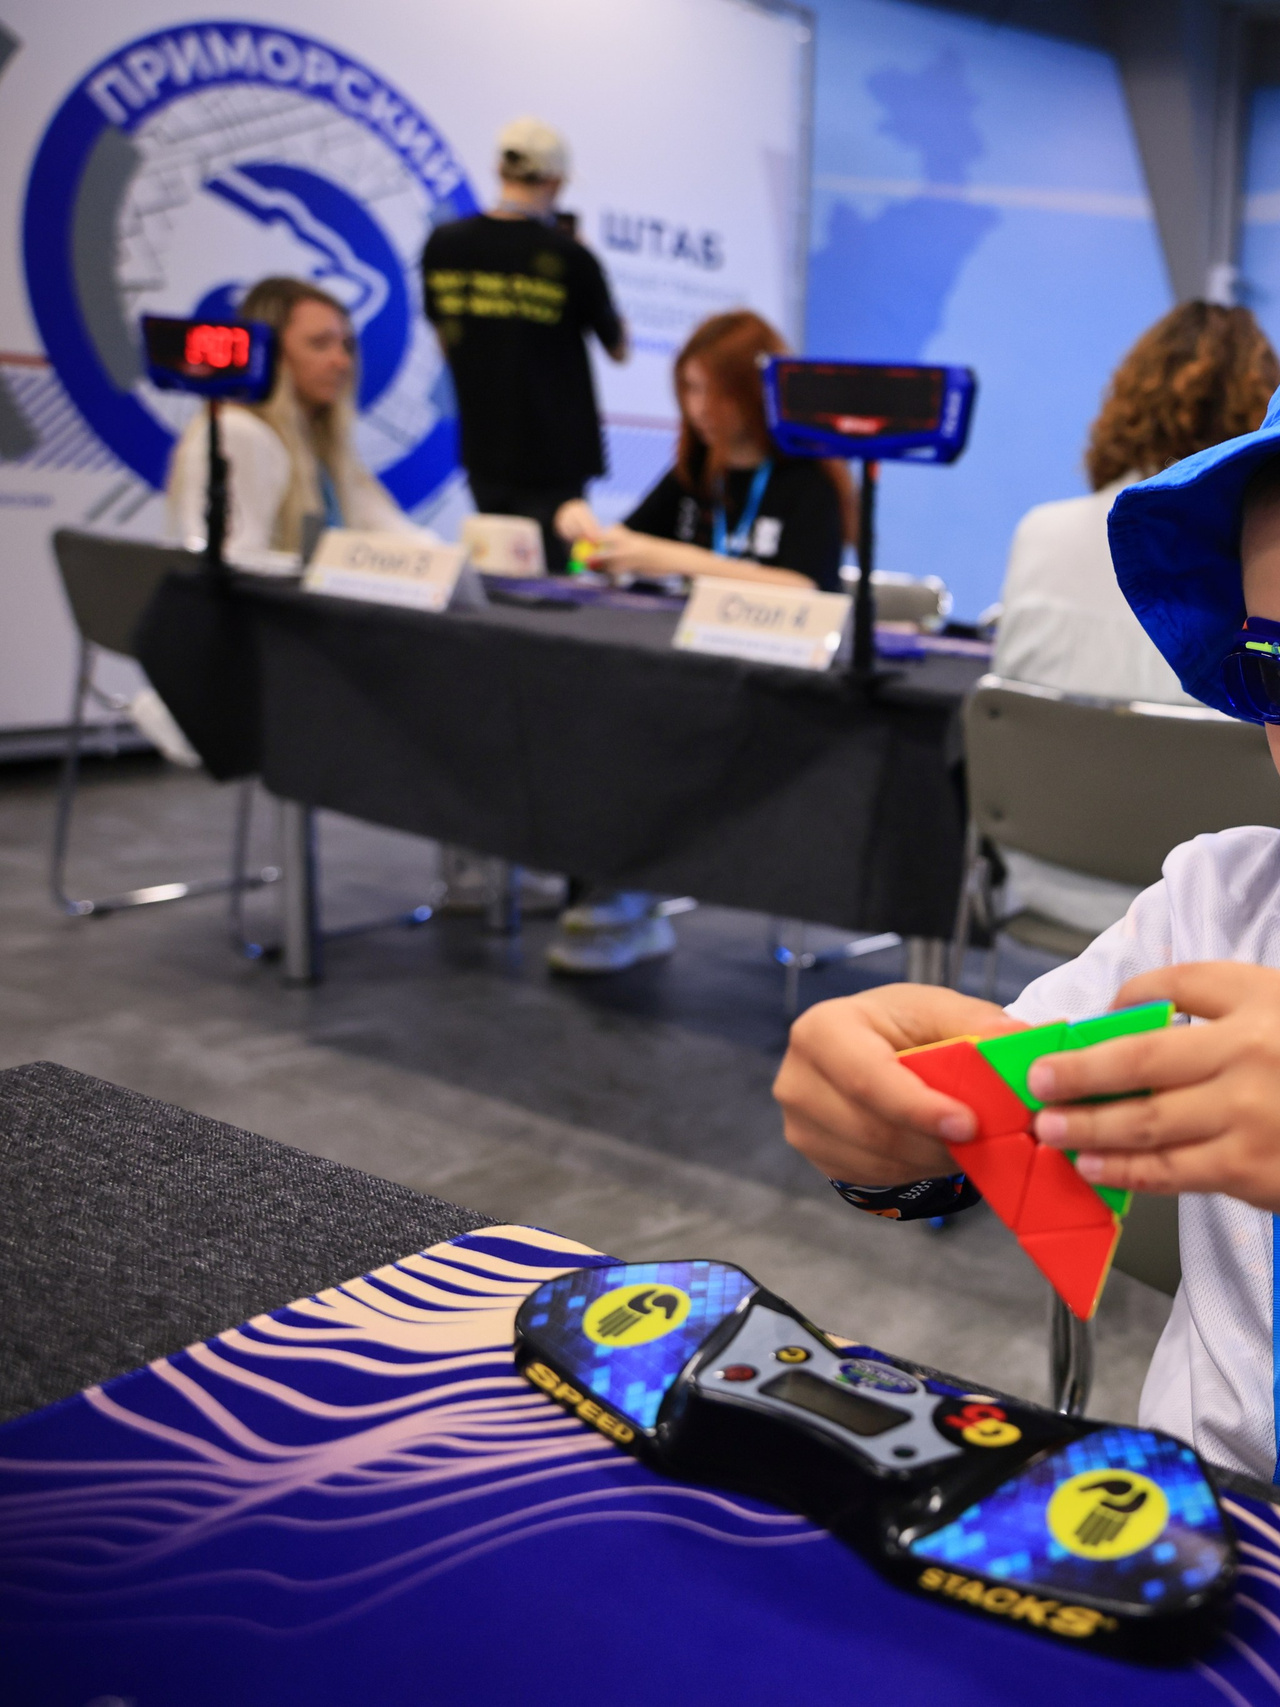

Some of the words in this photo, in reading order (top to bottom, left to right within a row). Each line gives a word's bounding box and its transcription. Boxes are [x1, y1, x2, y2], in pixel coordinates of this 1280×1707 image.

[87, 28, 463, 199] ПРИМОРСКИЙ
[602, 212, 724, 271] ШТАБ
[525, 1362, 635, 1443] SPEED
